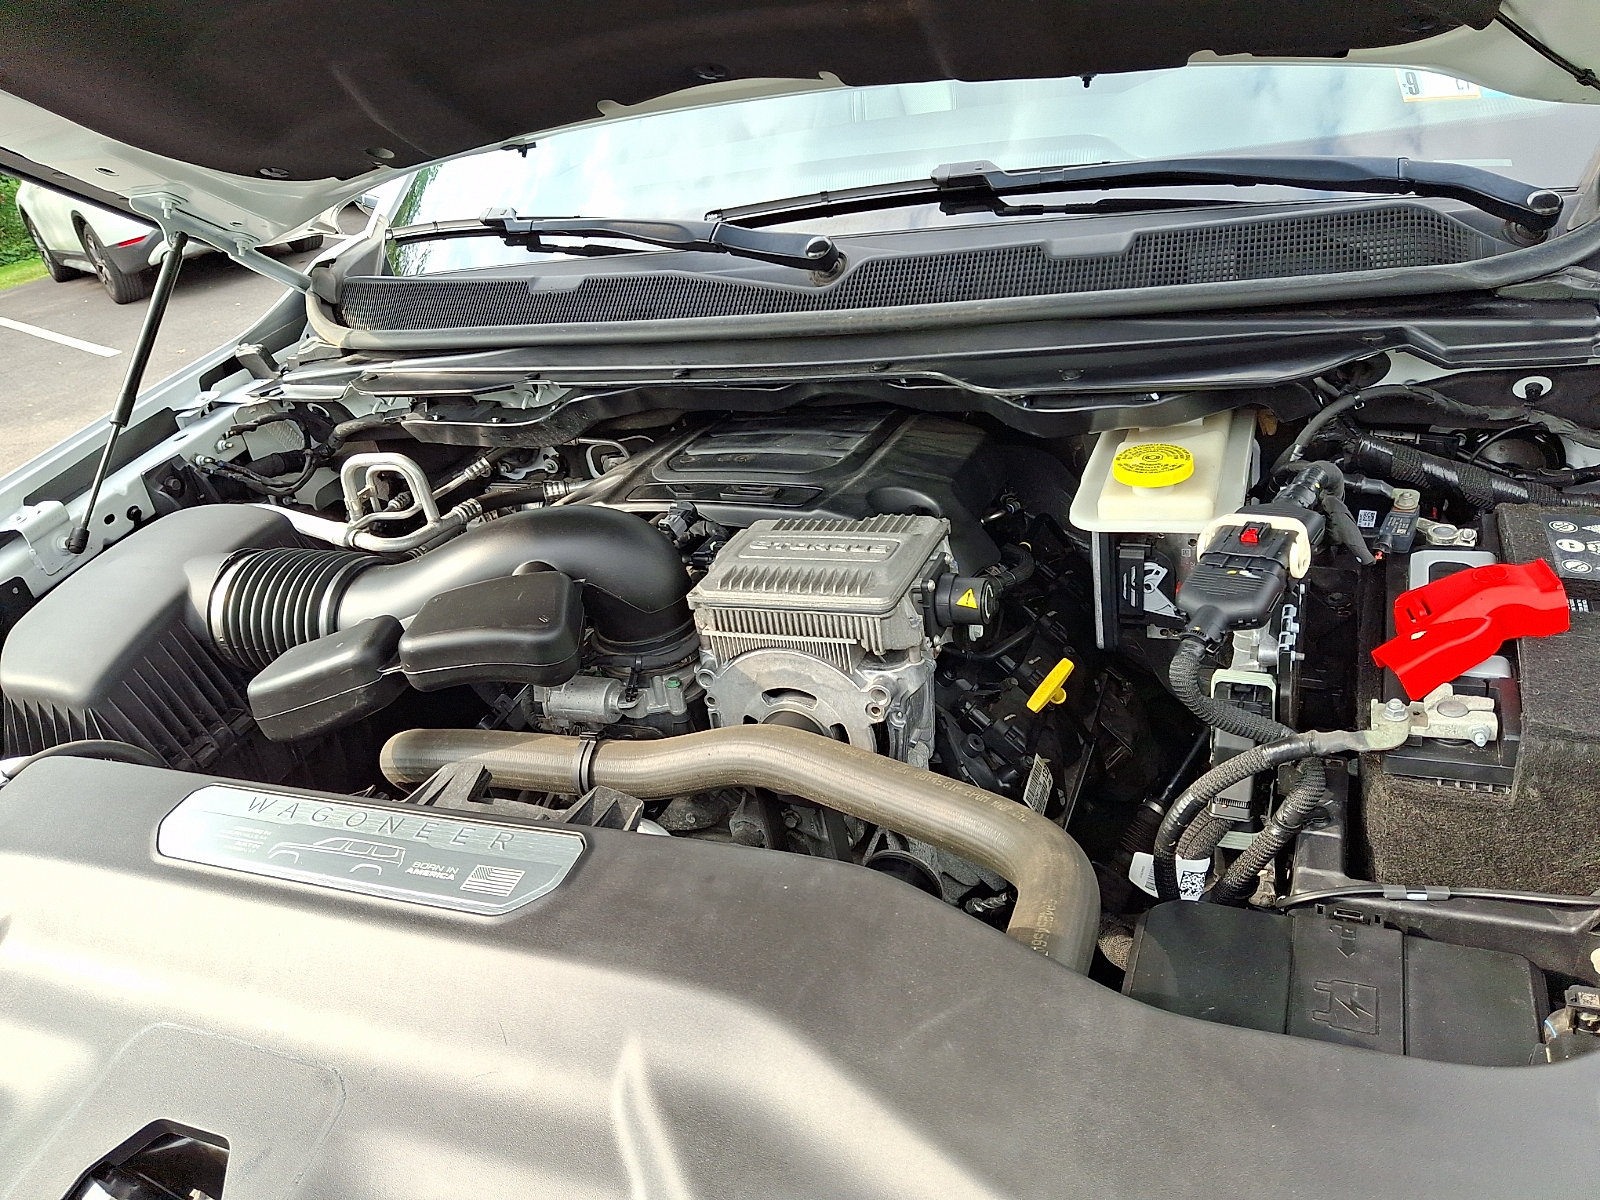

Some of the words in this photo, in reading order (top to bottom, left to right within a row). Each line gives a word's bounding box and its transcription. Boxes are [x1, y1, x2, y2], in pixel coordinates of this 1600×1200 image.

[248, 796, 515, 851] WAGONEER
[405, 868, 455, 881] AMERICA
[411, 861, 445, 872] BORN
[446, 866, 459, 875] IN
